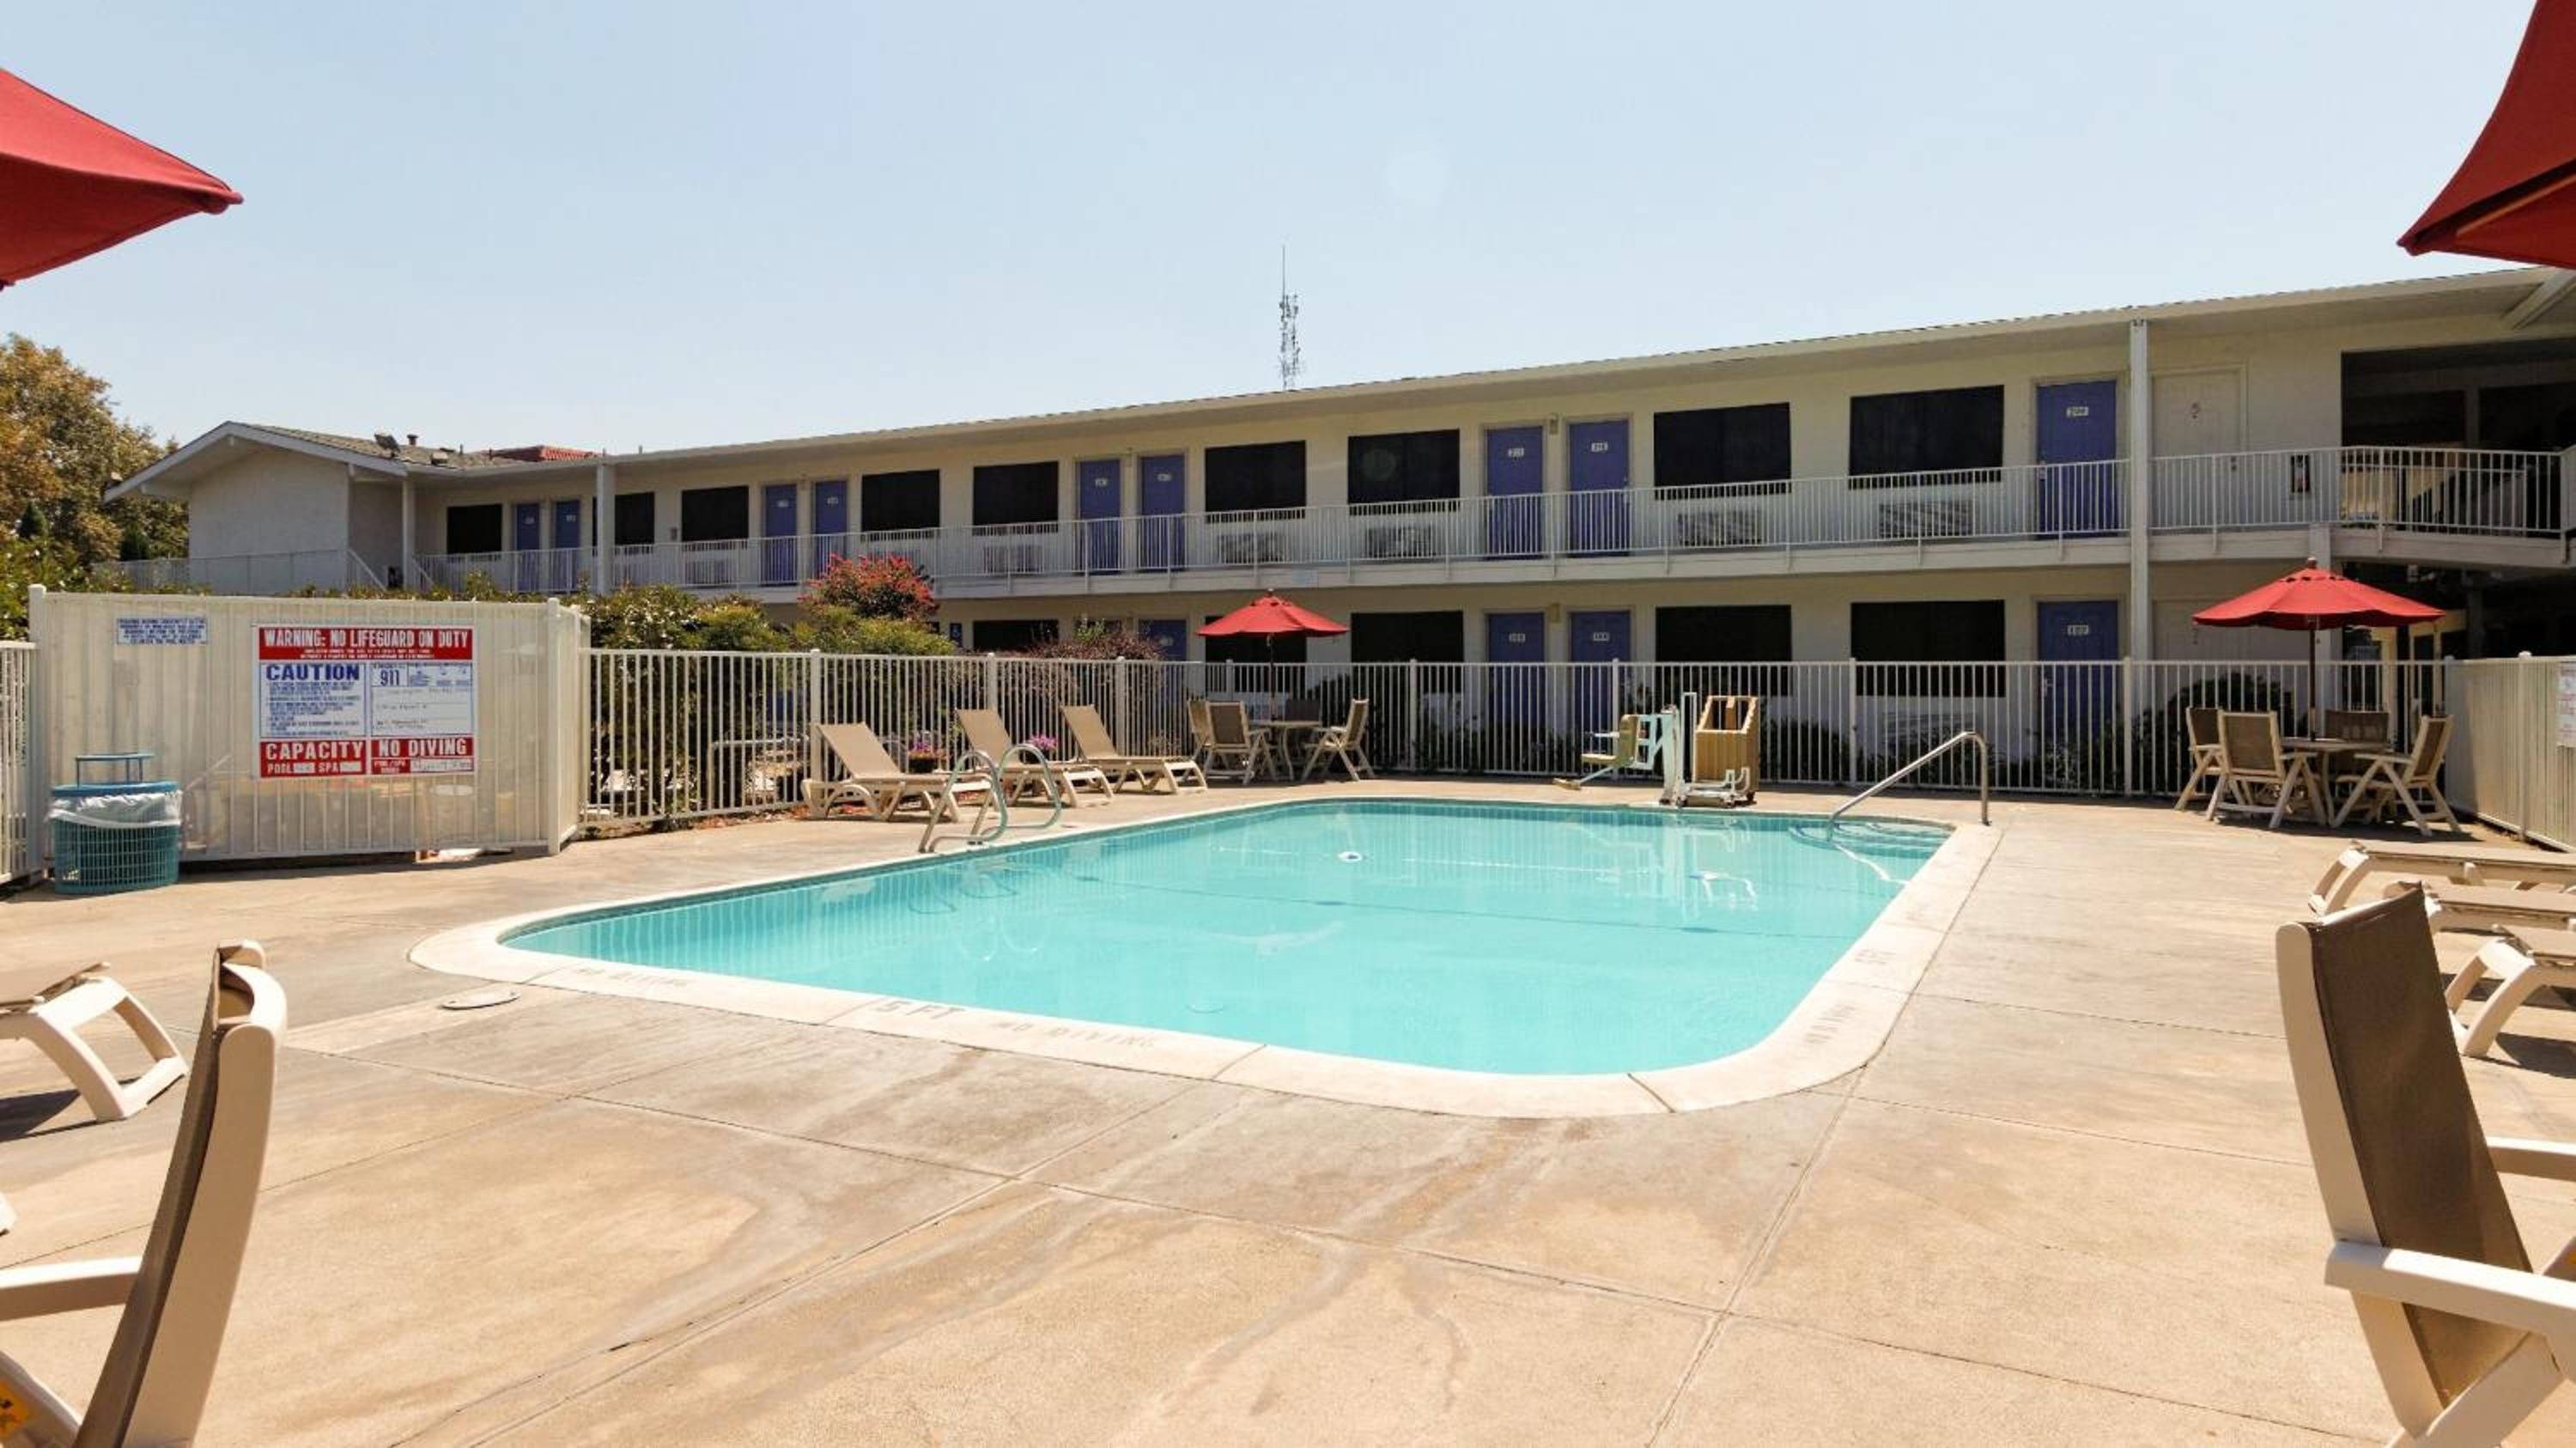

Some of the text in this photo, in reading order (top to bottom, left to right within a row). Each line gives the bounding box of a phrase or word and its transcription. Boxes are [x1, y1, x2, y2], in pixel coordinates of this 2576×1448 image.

[264, 629, 468, 648] WARNING: NO LIFEGUARD ON DUTY
[266, 664, 360, 681] CAUTION
[380, 670, 400, 686] 911
[266, 741, 363, 760] CAPACITY
[380, 738, 467, 757] NO DIVING
[267, 763, 293, 774] POOL
[319, 762, 338, 773] SPA
